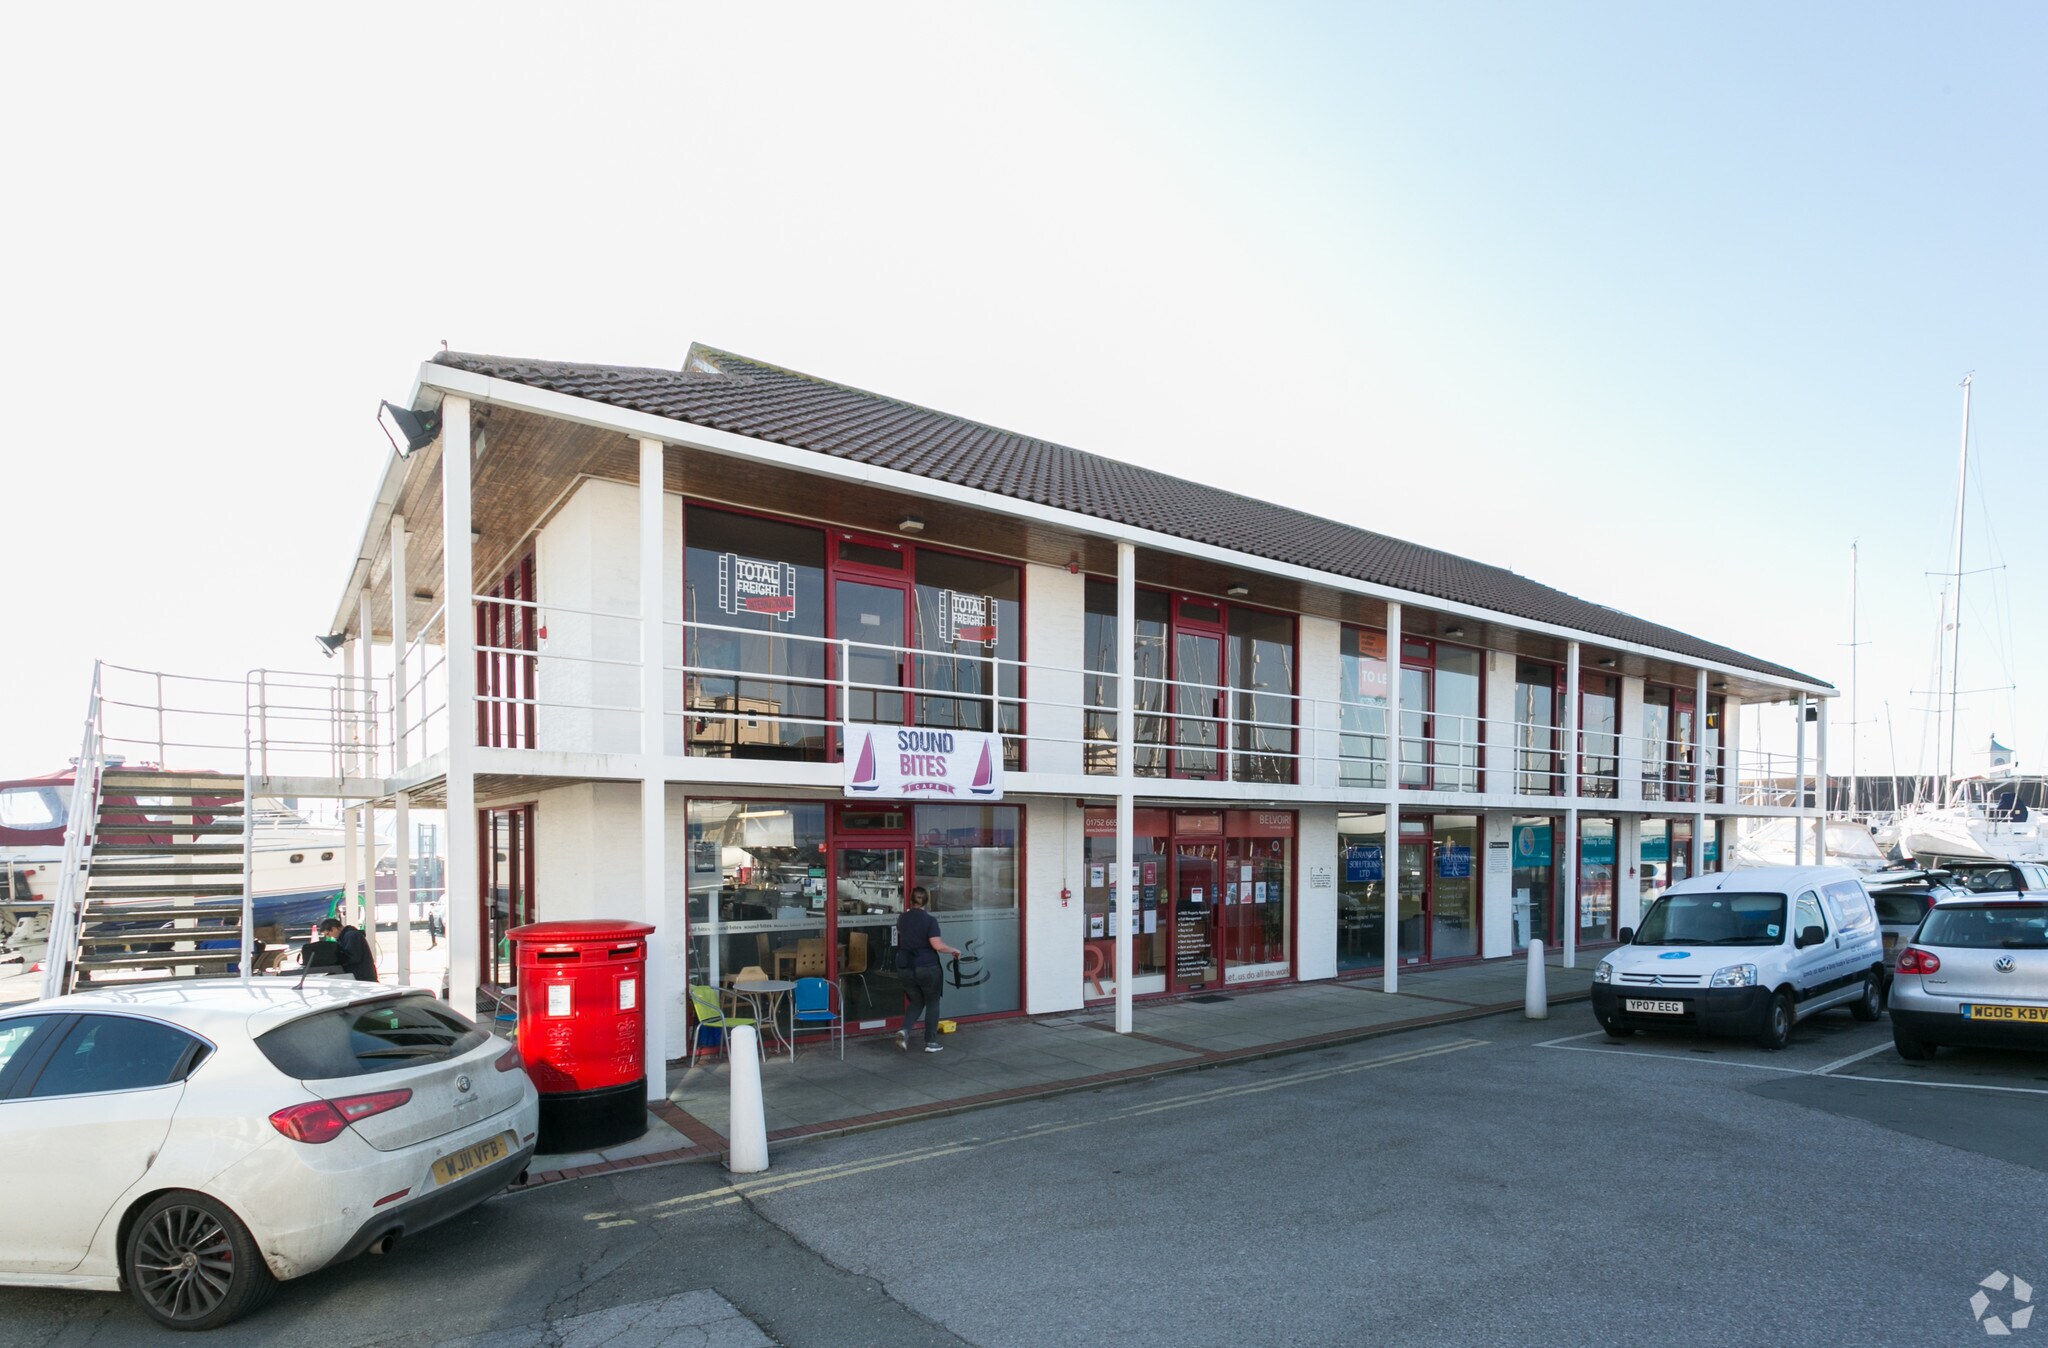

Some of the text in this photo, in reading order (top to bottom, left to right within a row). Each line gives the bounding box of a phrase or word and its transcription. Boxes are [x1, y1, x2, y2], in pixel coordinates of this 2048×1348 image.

[737, 562, 779, 584] TOTAL
[737, 580, 779, 597] FREIGHT
[953, 597, 985, 615] TOTAL
[953, 613, 985, 627] FREIGHT
[1362, 670, 1375, 682] TO
[898, 730, 954, 754] SOUND
[900, 754, 948, 777] BITES
[1086, 818, 1105, 827] 01752
[1259, 814, 1292, 825] BELVOIR!
[1352, 851, 1378, 859] FINANCE
[1349, 860, 1380, 869] SOLUTIONS
[1360, 869, 1370, 878] LTD
[1247, 970, 1255, 979] do
[1256, 969, 1264, 978] all
[1265, 969, 1275, 977] the
[1630, 1001, 1679, 1012] YP07 EEG
[1974, 1006, 2048, 1020] WG06 KBV
[445, 1141, 499, 1177] WJ11 VFB
